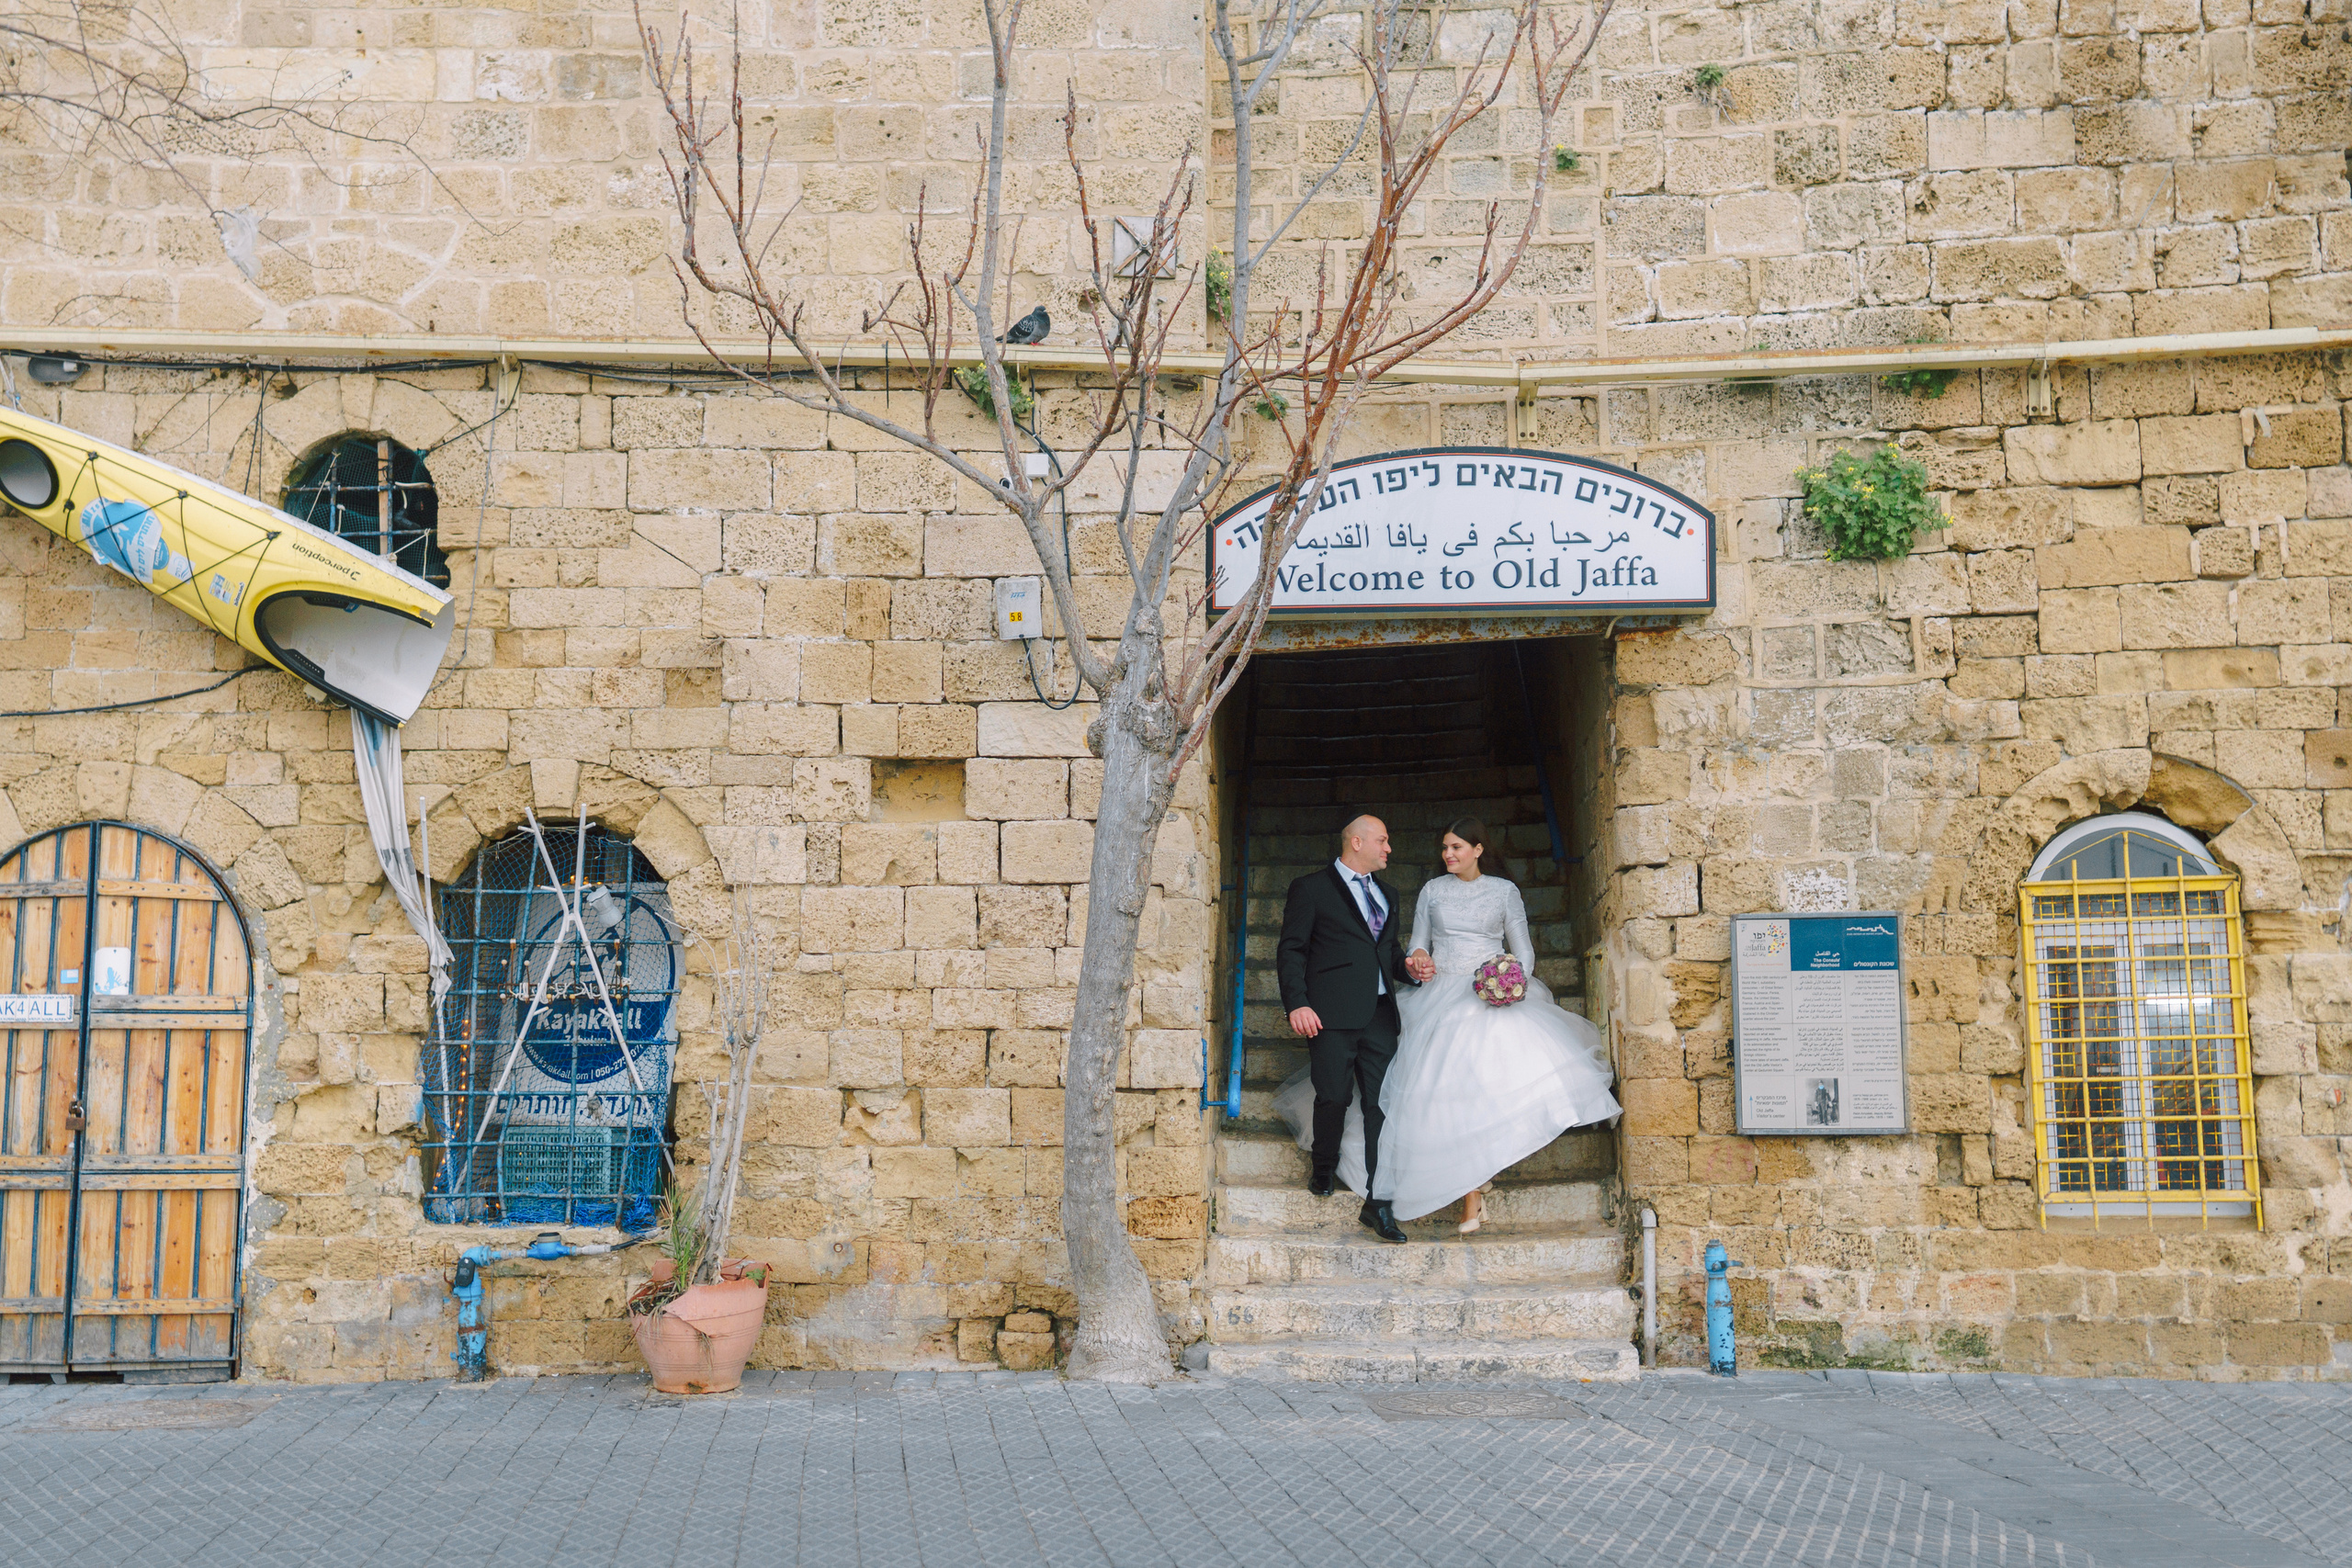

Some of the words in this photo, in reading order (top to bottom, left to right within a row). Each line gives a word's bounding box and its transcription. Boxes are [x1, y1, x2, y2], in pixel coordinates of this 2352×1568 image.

[1373, 460, 1441, 494] ליפו
[1457, 463, 1563, 495] הבאים
[1233, 477, 1361, 549] העה
[1575, 477, 1687, 539] ברוכים
[1293, 522, 1369, 557] القديم
[1386, 524, 1428, 555] يافا
[1494, 521, 1534, 558] بكم
[292, 543, 351, 574] perception
[1440, 565, 1475, 590] to
[1492, 558, 1561, 590] Old
[1572, 556, 1658, 596] Jaffa
